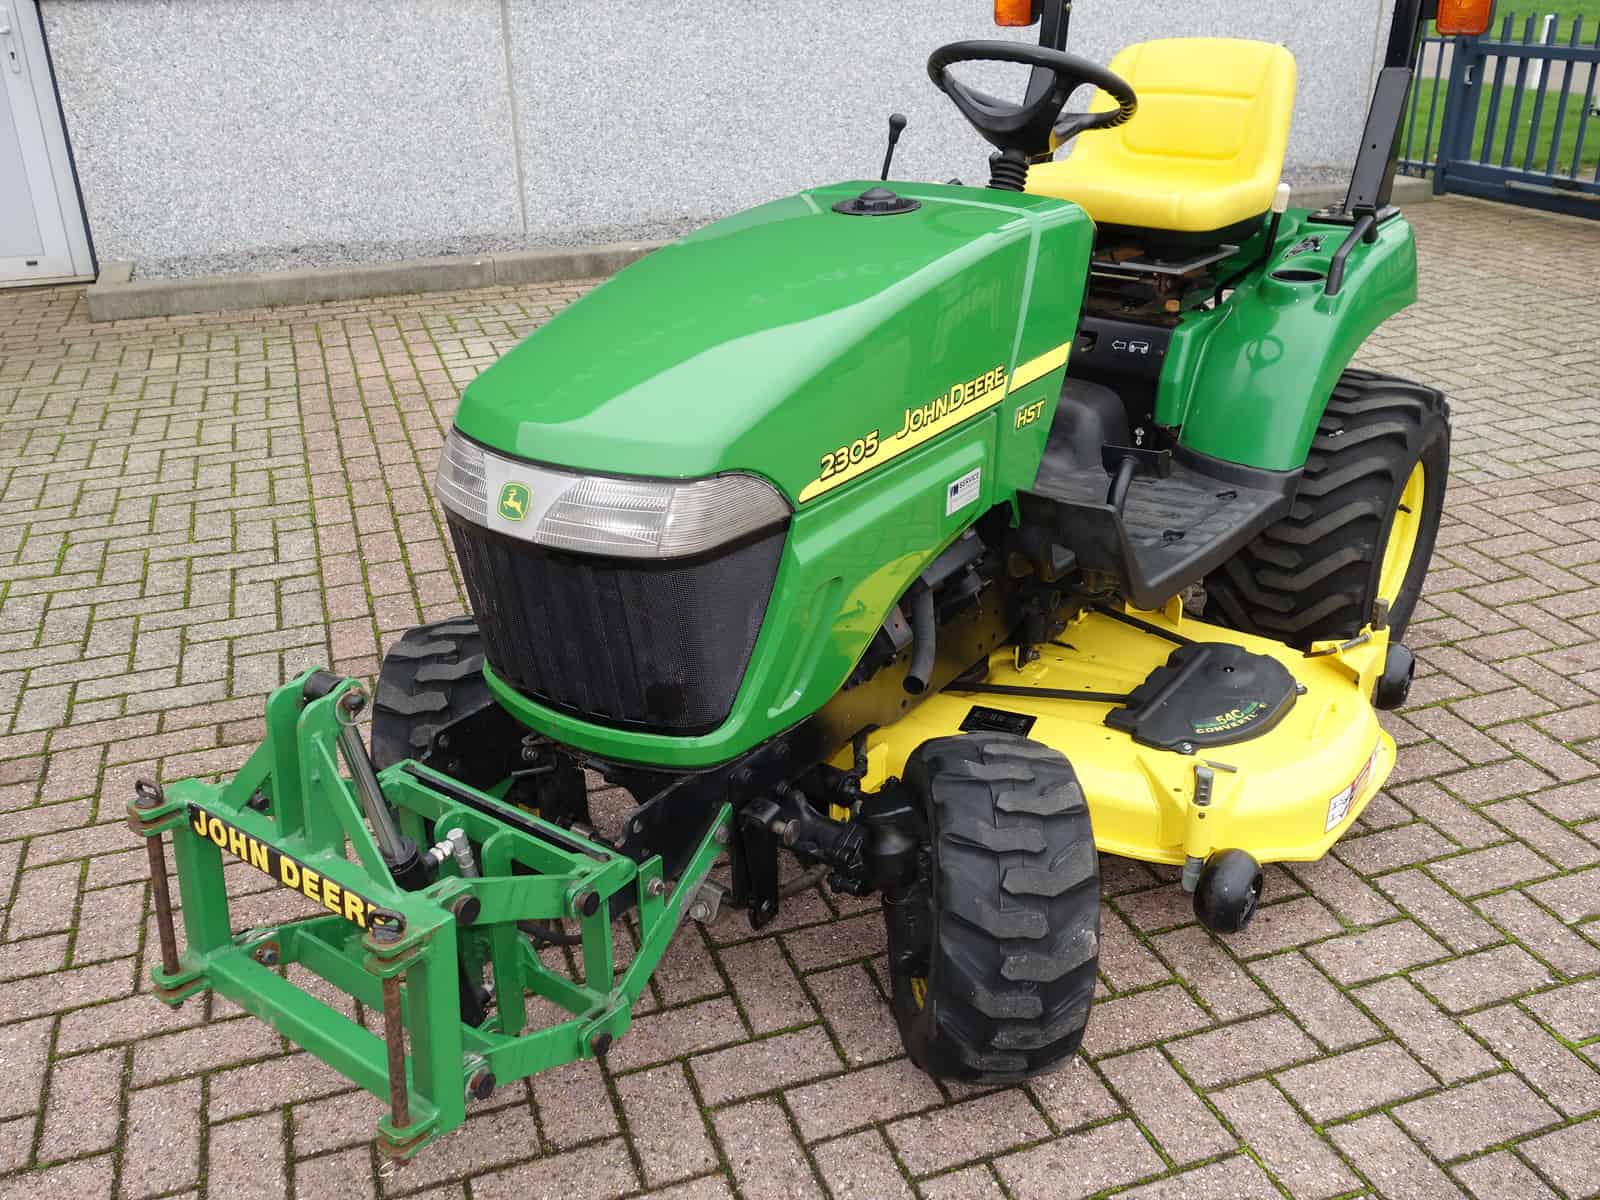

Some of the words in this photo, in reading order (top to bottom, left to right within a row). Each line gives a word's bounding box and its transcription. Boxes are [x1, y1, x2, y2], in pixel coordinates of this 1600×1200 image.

[820, 429, 880, 482] 2305
[896, 393, 948, 440] JOHN
[949, 365, 1006, 412] DEERE
[1016, 399, 1046, 431] HST
[1216, 708, 1245, 725] 54C
[193, 810, 270, 873] JOHN
